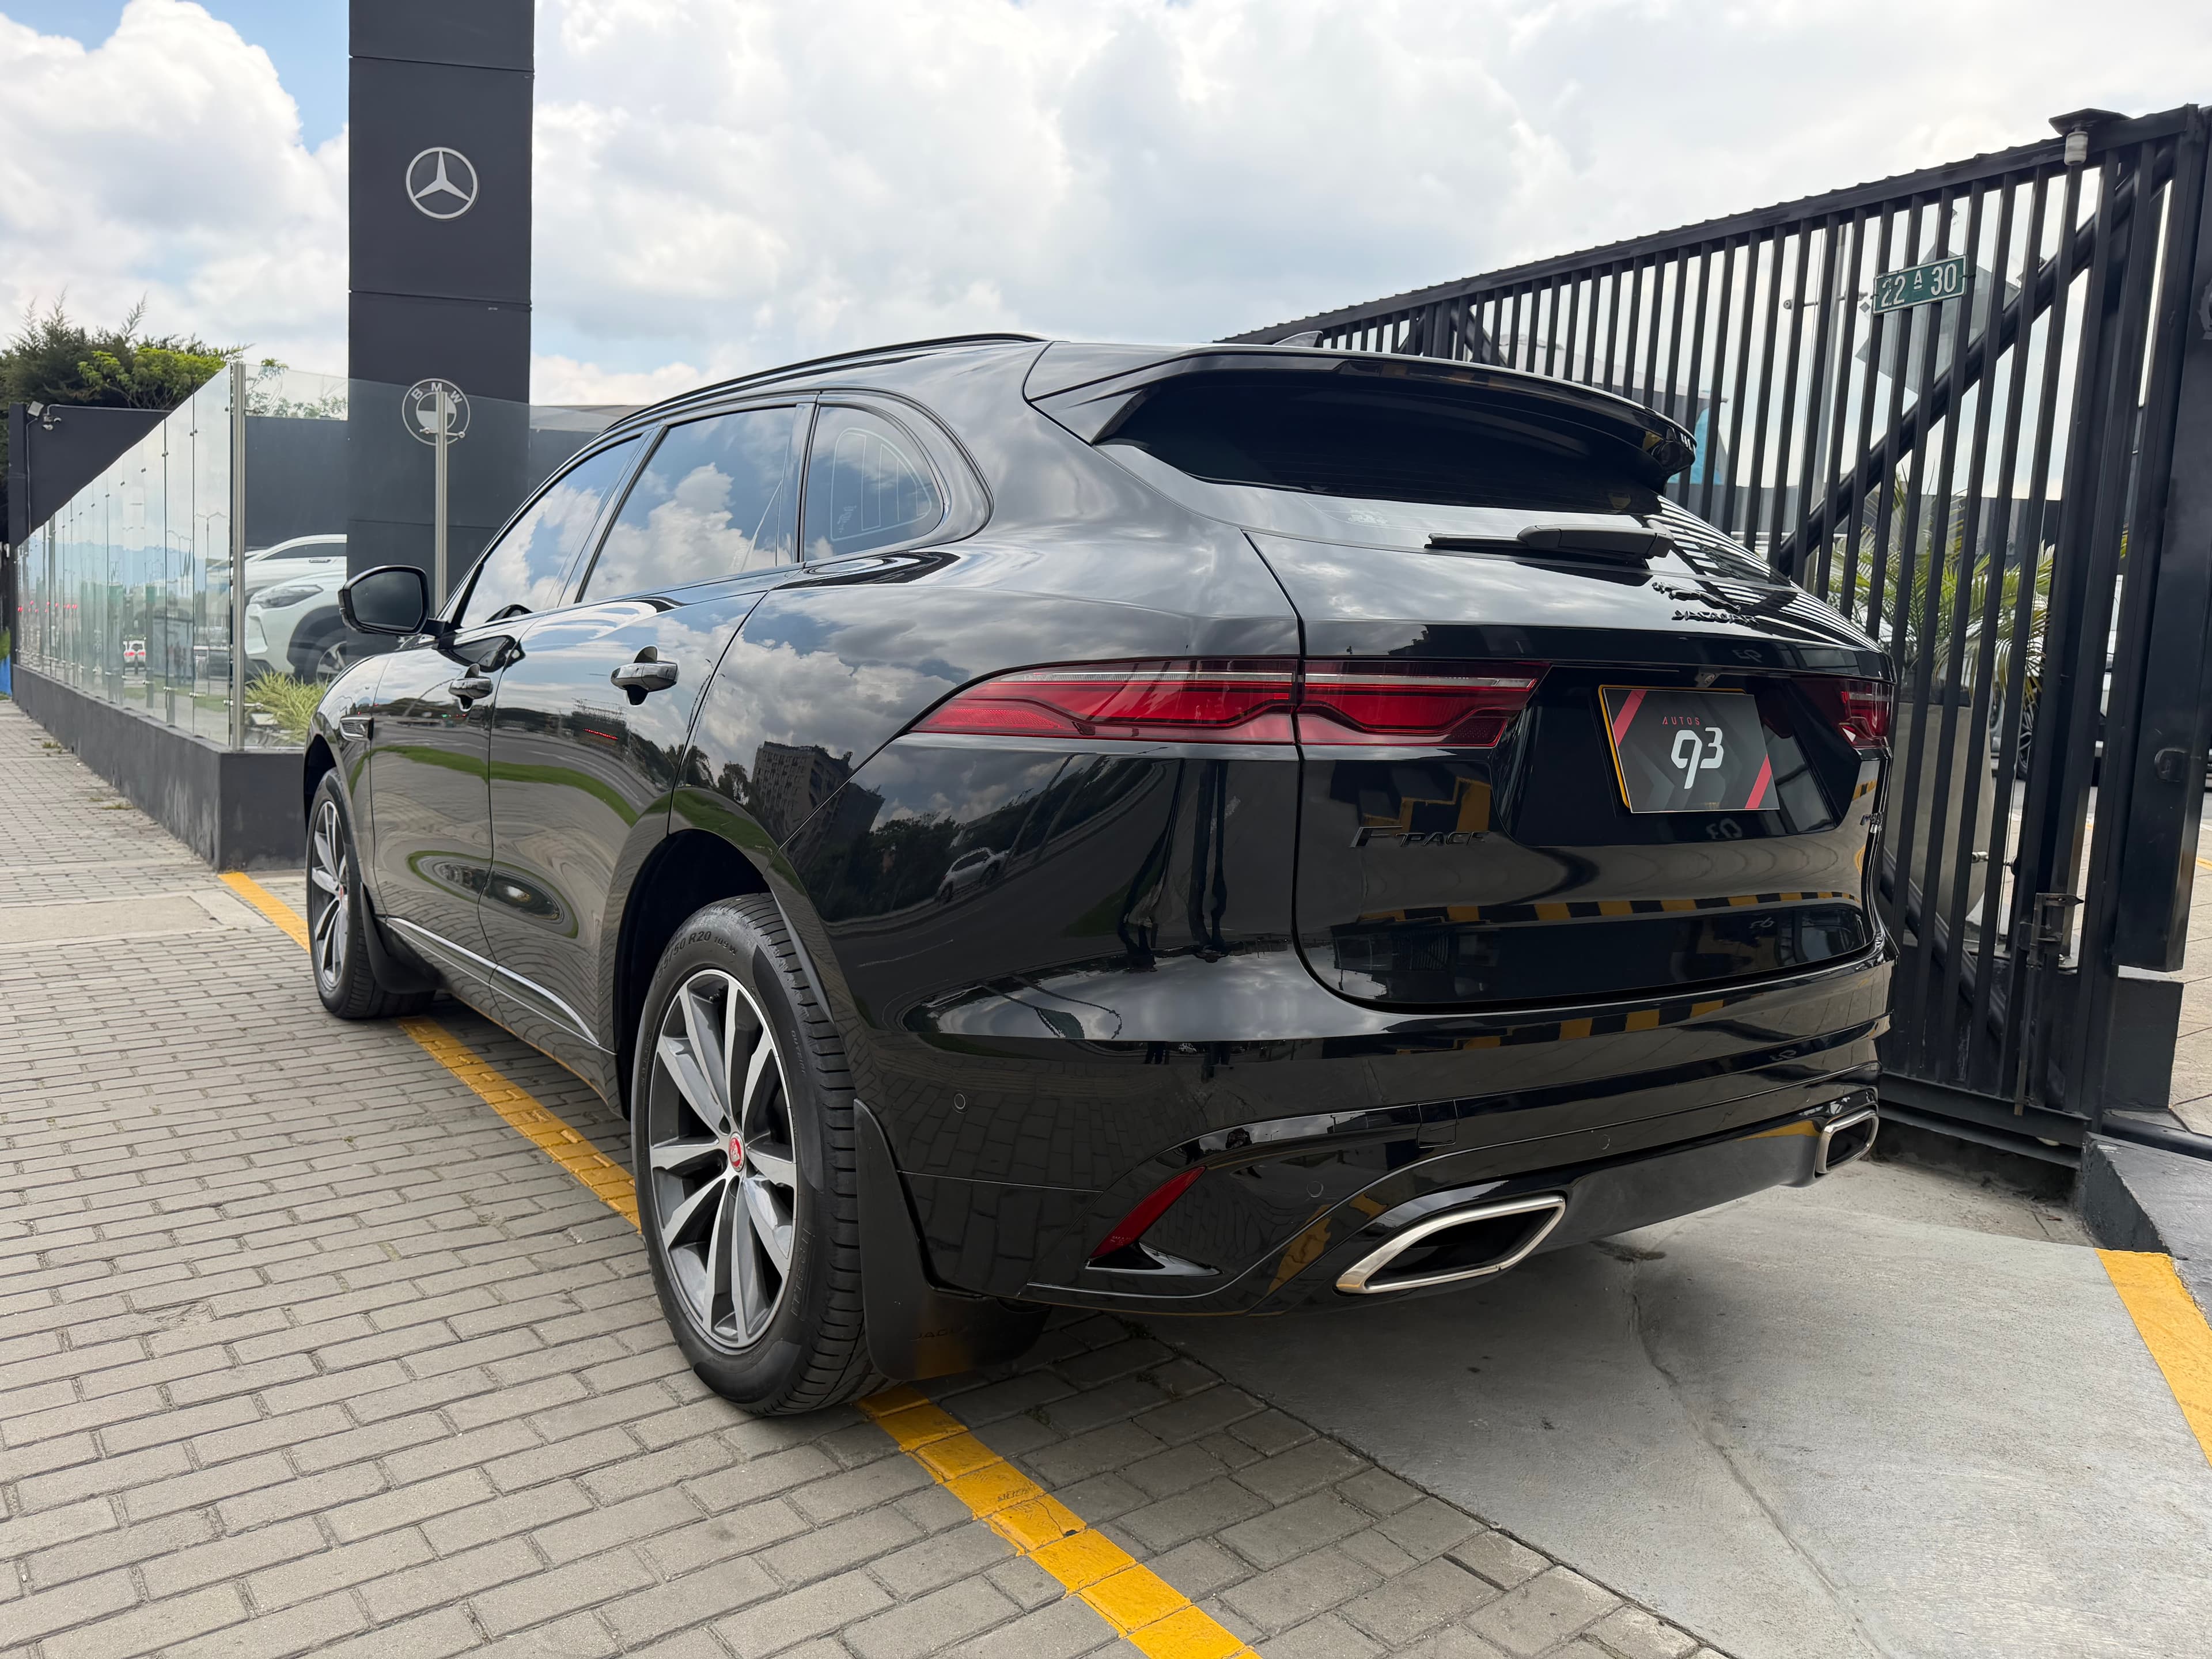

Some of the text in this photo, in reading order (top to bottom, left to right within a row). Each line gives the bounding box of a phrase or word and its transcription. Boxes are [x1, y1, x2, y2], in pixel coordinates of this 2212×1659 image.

[1880, 275, 1906, 308] 22
[1930, 263, 1957, 296] 30
[411, 382, 463, 404] BMW
[1662, 716, 1700, 726] AUTOS
[1671, 726, 1724, 790] 93
[688, 930, 712, 945] R20
